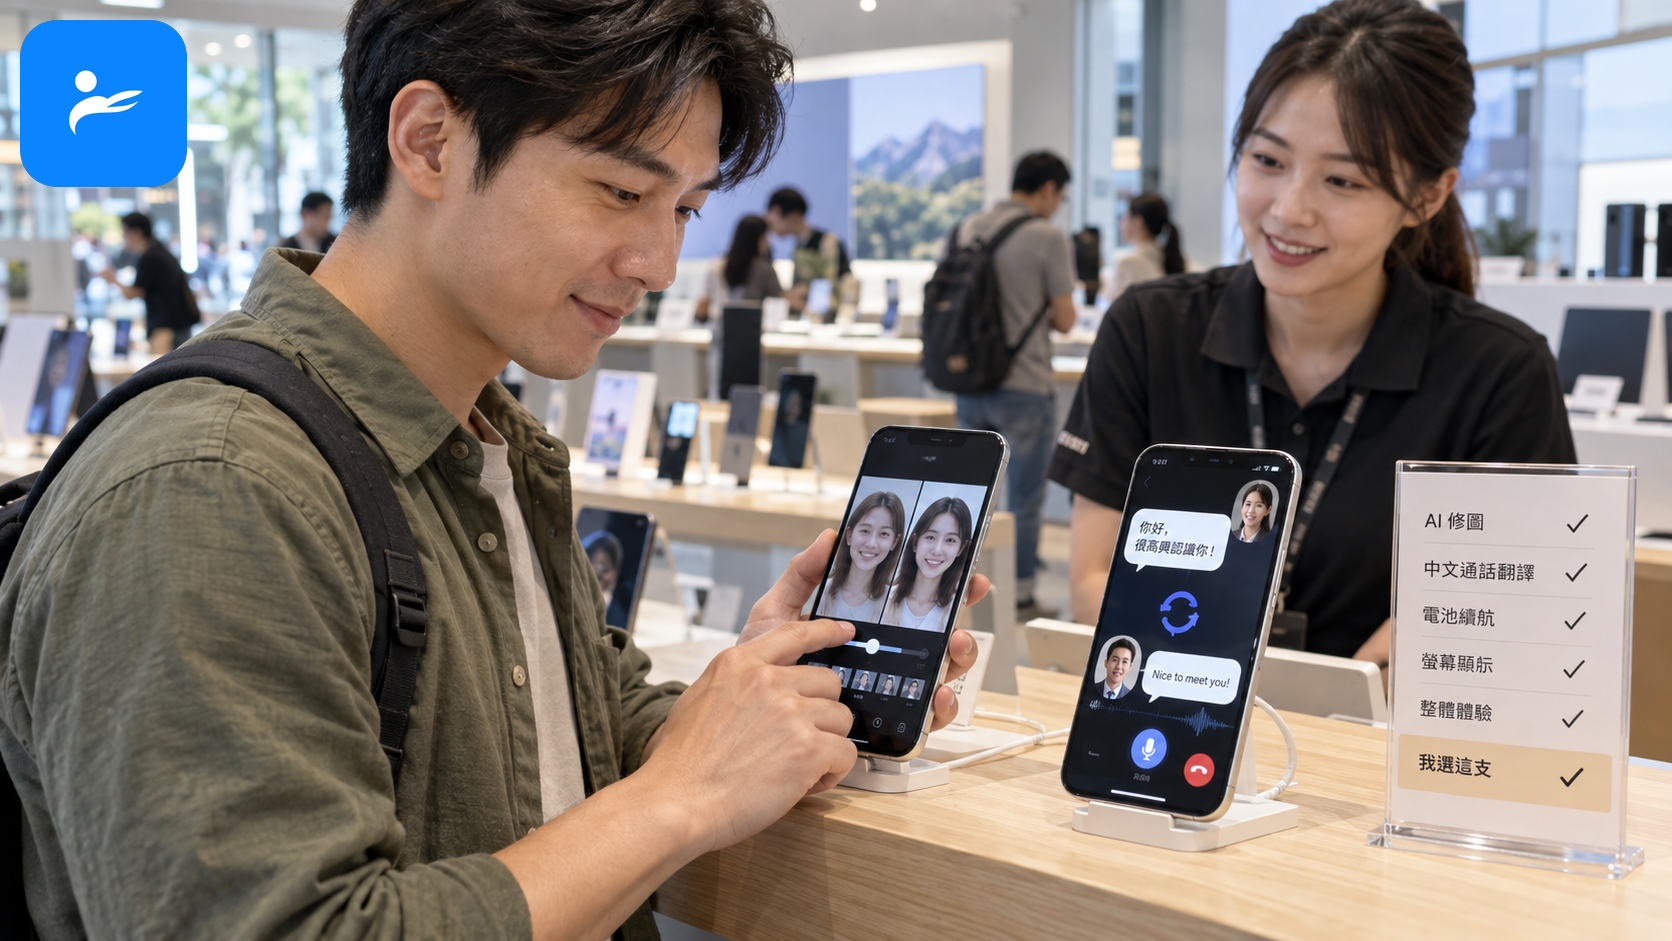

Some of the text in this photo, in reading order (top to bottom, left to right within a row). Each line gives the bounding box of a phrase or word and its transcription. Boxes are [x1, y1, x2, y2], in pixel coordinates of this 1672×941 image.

[1424, 512, 1484, 532] AI 修圖
[1424, 560, 1535, 582] 中文通話翻譯
[1423, 606, 1495, 627] 電池續航
[1152, 669, 1231, 689] Nice to meet you!
[1420, 700, 1493, 723] 整體體驗
[1419, 754, 1492, 779] 我選這支
